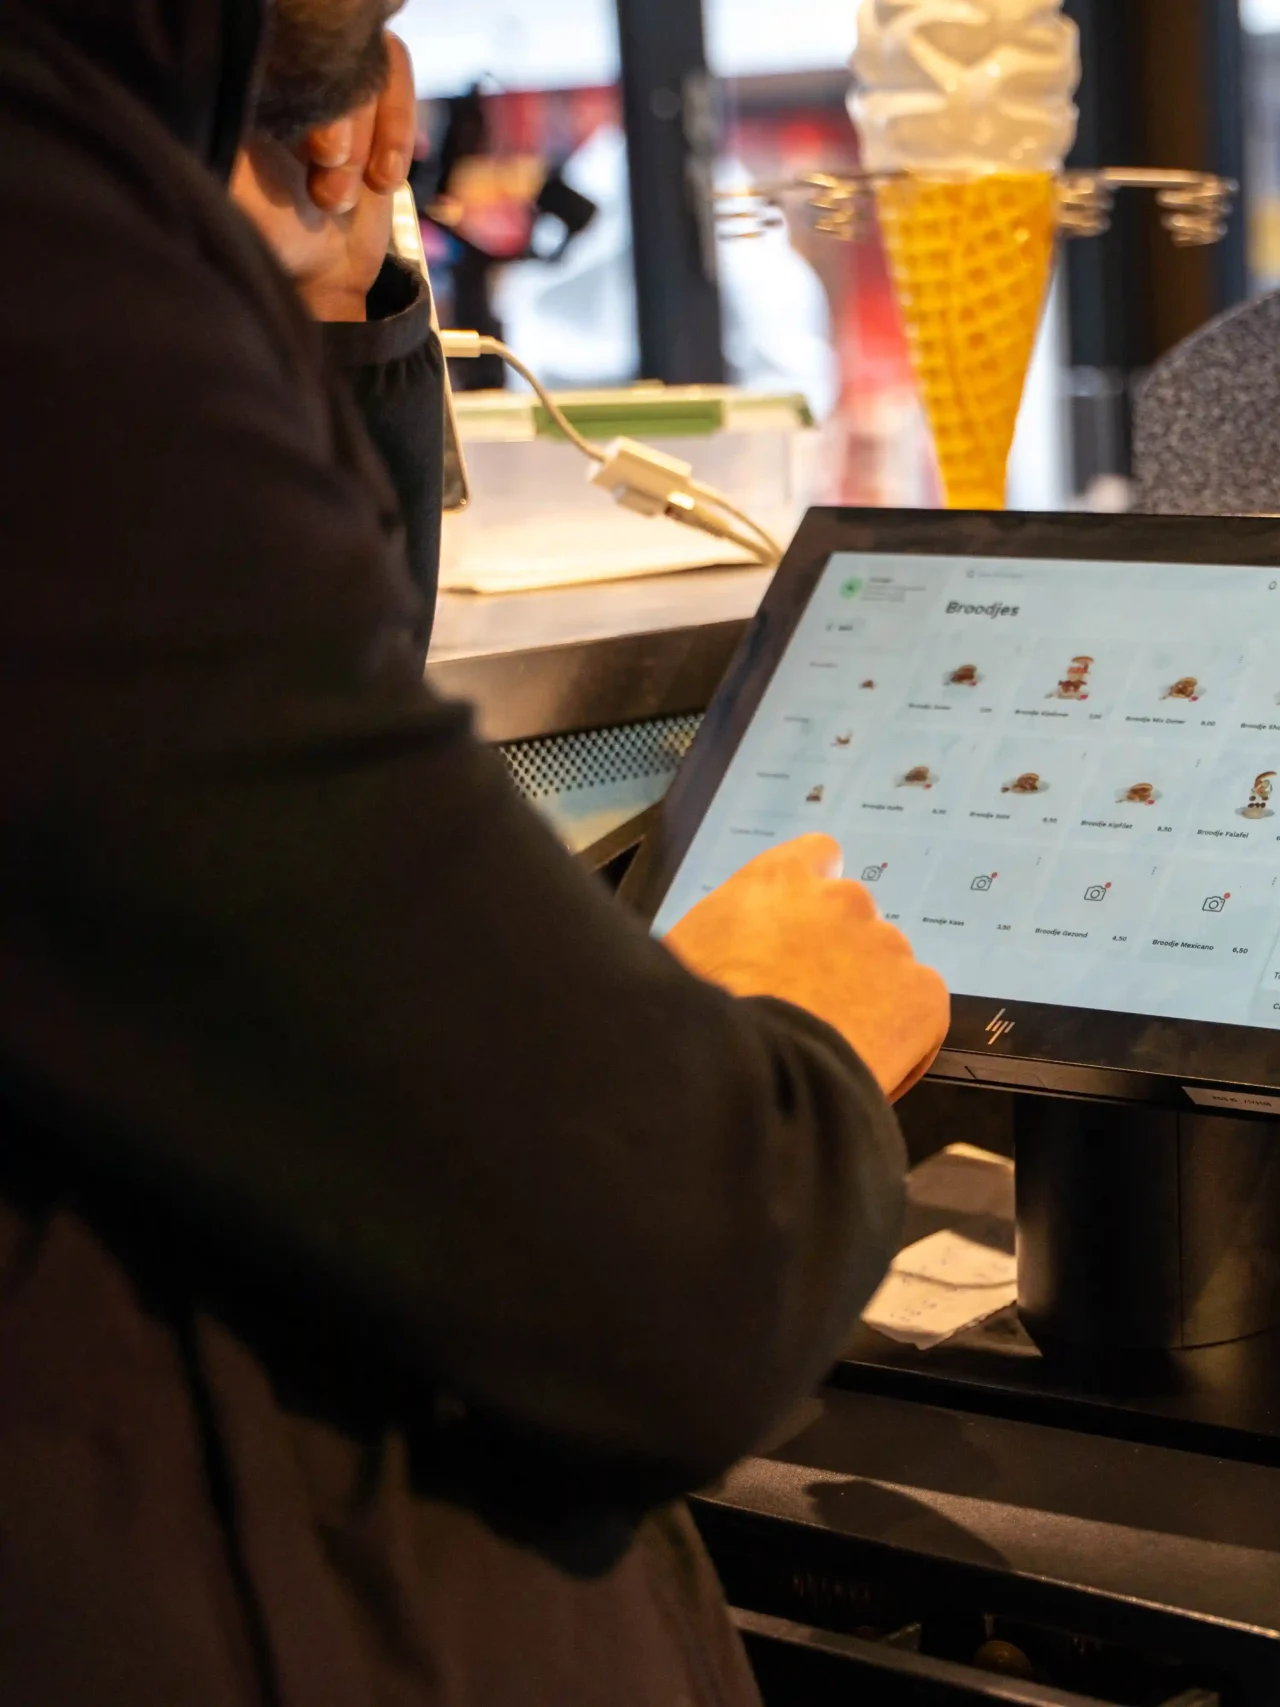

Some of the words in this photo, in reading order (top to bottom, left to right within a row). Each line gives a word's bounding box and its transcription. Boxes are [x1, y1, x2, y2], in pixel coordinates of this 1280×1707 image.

[945, 600, 1020, 619] Broodjes
[1125, 714, 1151, 724] Broodje
[1240, 722, 1266, 731] Broodje
[1081, 819, 1106, 830] Broodje
[1108, 821, 1133, 831] Kipfilet
[1196, 829, 1224, 839] Broodje
[1225, 831, 1249, 840] Falafel
[922, 916, 948, 926] Broodje
[1034, 926, 1061, 937] Broodje
[1063, 929, 1089, 939] Gezond
[1112, 935, 1127, 943] 4,50
[1152, 938, 1179, 949] Broodje
[1180, 940, 1215, 951] Mexicano
